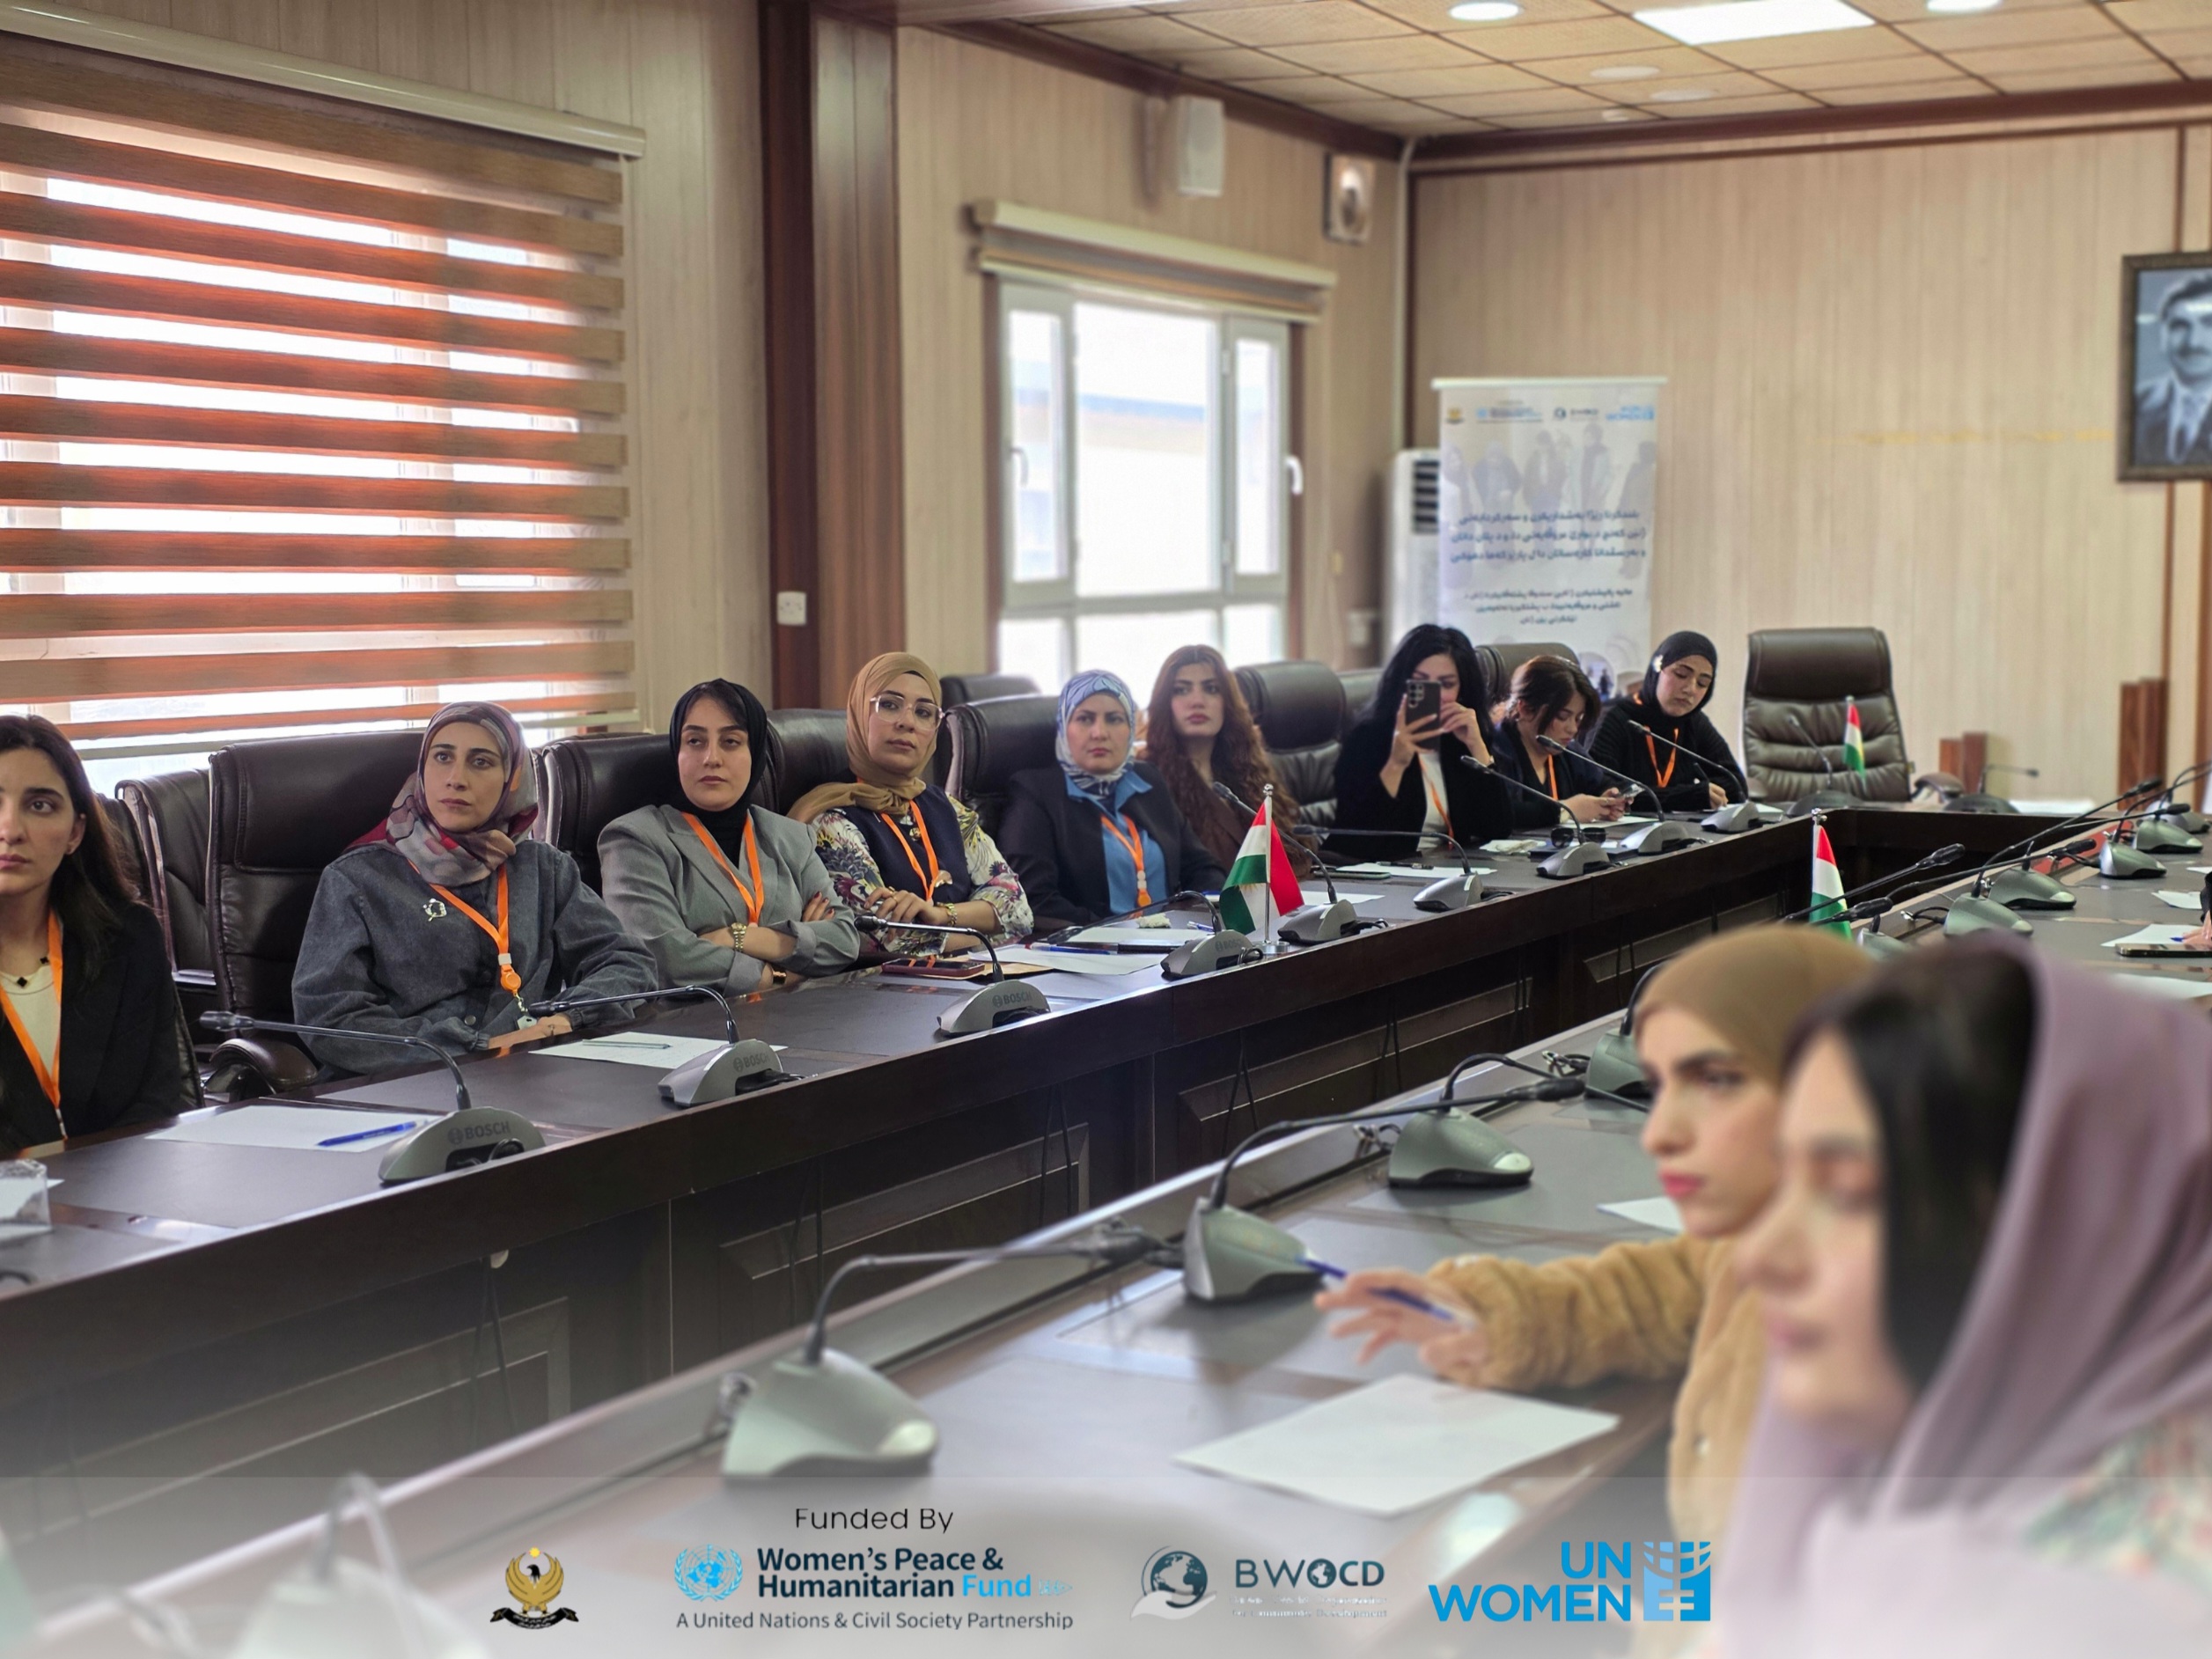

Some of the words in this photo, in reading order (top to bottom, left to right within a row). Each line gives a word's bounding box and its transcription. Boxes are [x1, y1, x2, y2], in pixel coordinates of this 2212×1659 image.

[1003, 991, 1033, 1005] BOSCH
[744, 1053, 770, 1068] BOSCH
[464, 1120, 511, 1140] BOSCH
